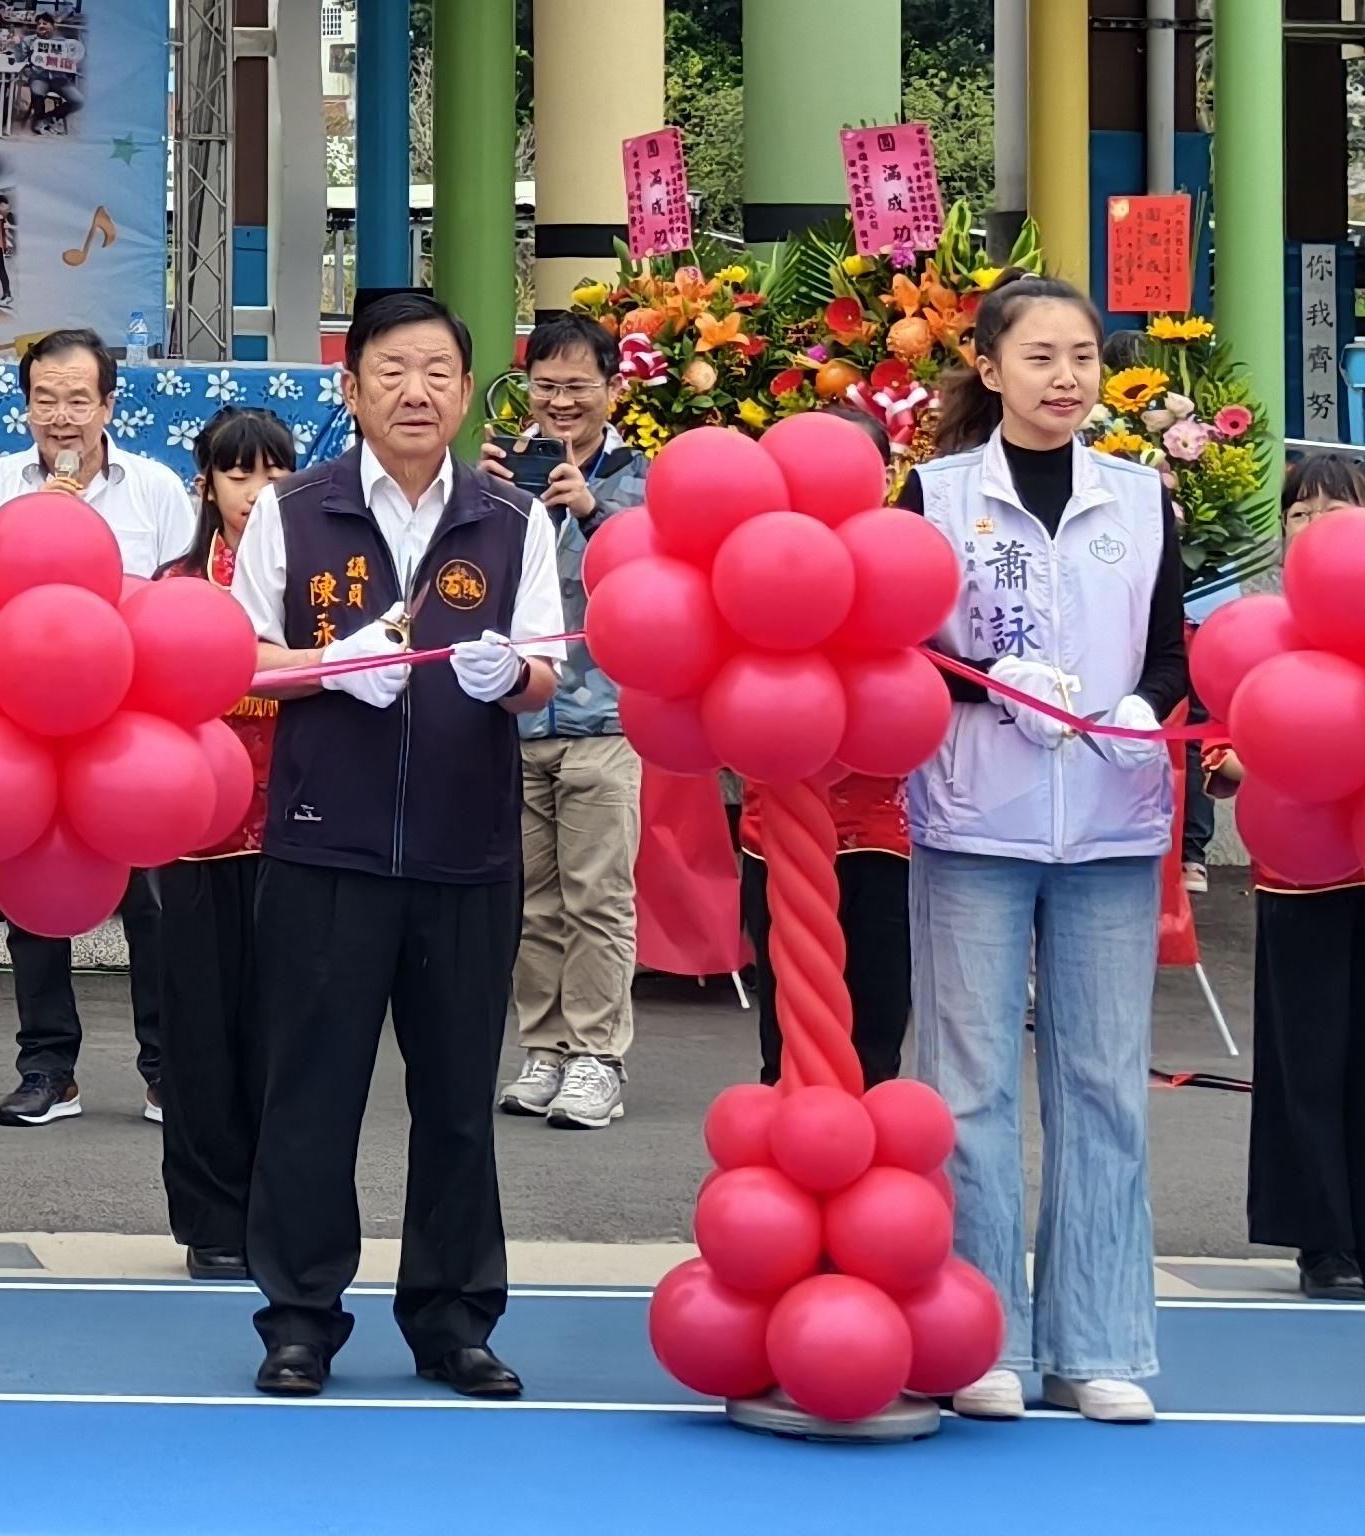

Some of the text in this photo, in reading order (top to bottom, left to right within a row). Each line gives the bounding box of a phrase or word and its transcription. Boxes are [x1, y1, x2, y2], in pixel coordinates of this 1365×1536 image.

[1305, 254, 1335, 420] 你我齊努
[346, 554, 369, 609] 議員
[984, 539, 1042, 658] 蕭詠
